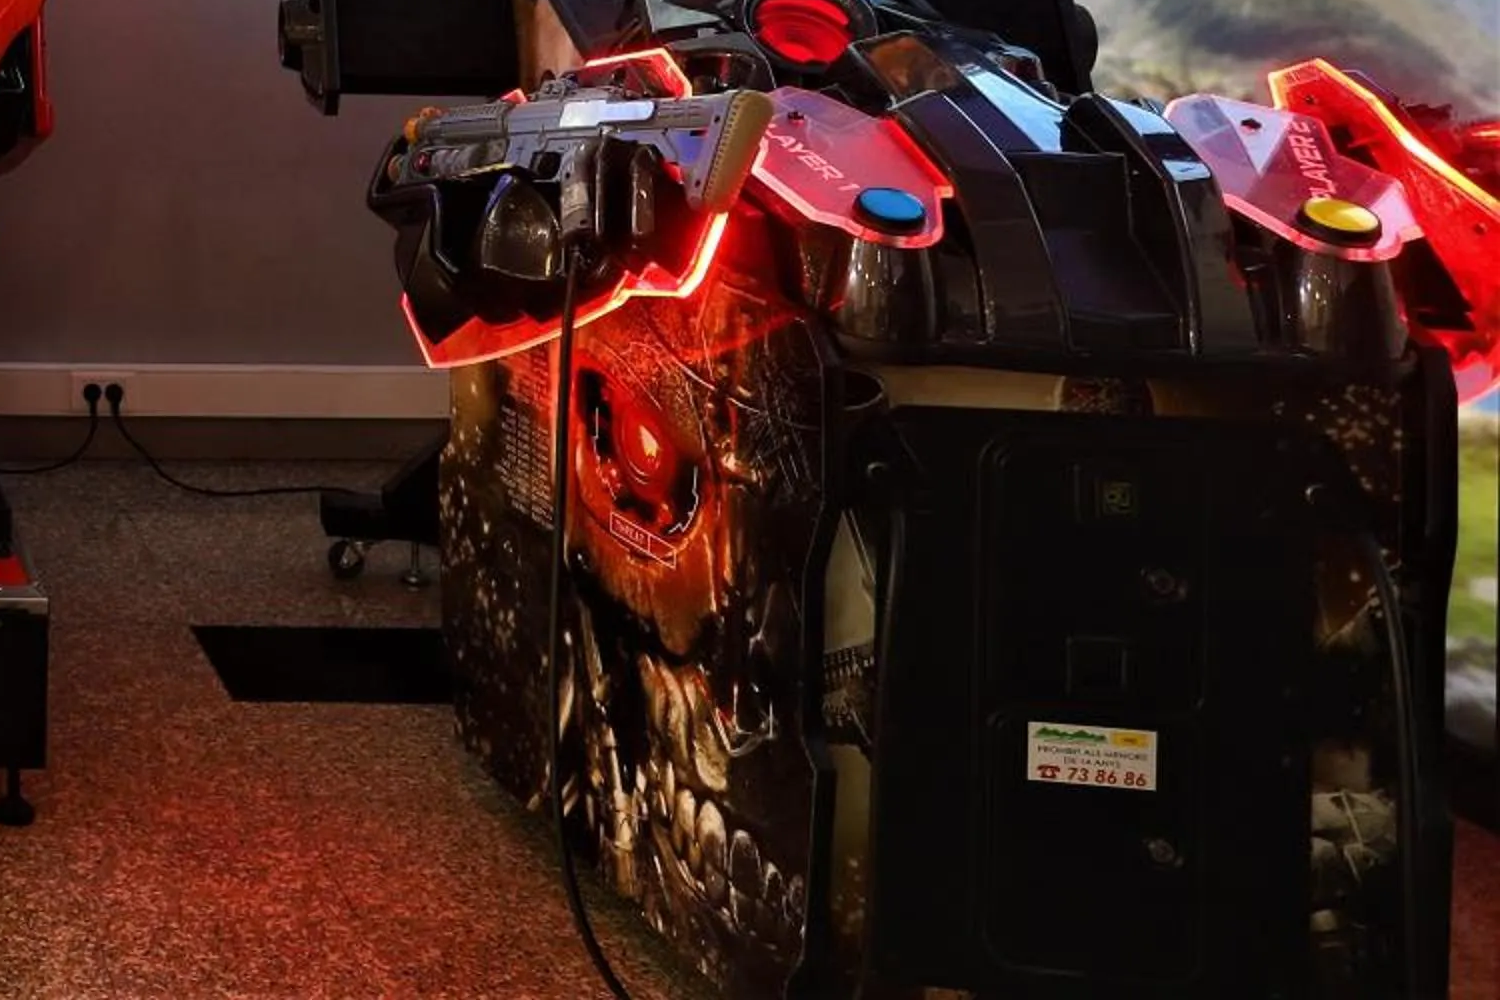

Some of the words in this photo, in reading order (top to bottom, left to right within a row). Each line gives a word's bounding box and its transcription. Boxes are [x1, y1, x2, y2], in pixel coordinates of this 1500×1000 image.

[765, 123, 845, 182] LAYER
[1067, 767, 1089, 782] 73
[1095, 769, 1117, 784] 86
[1123, 771, 1147, 787] 86
